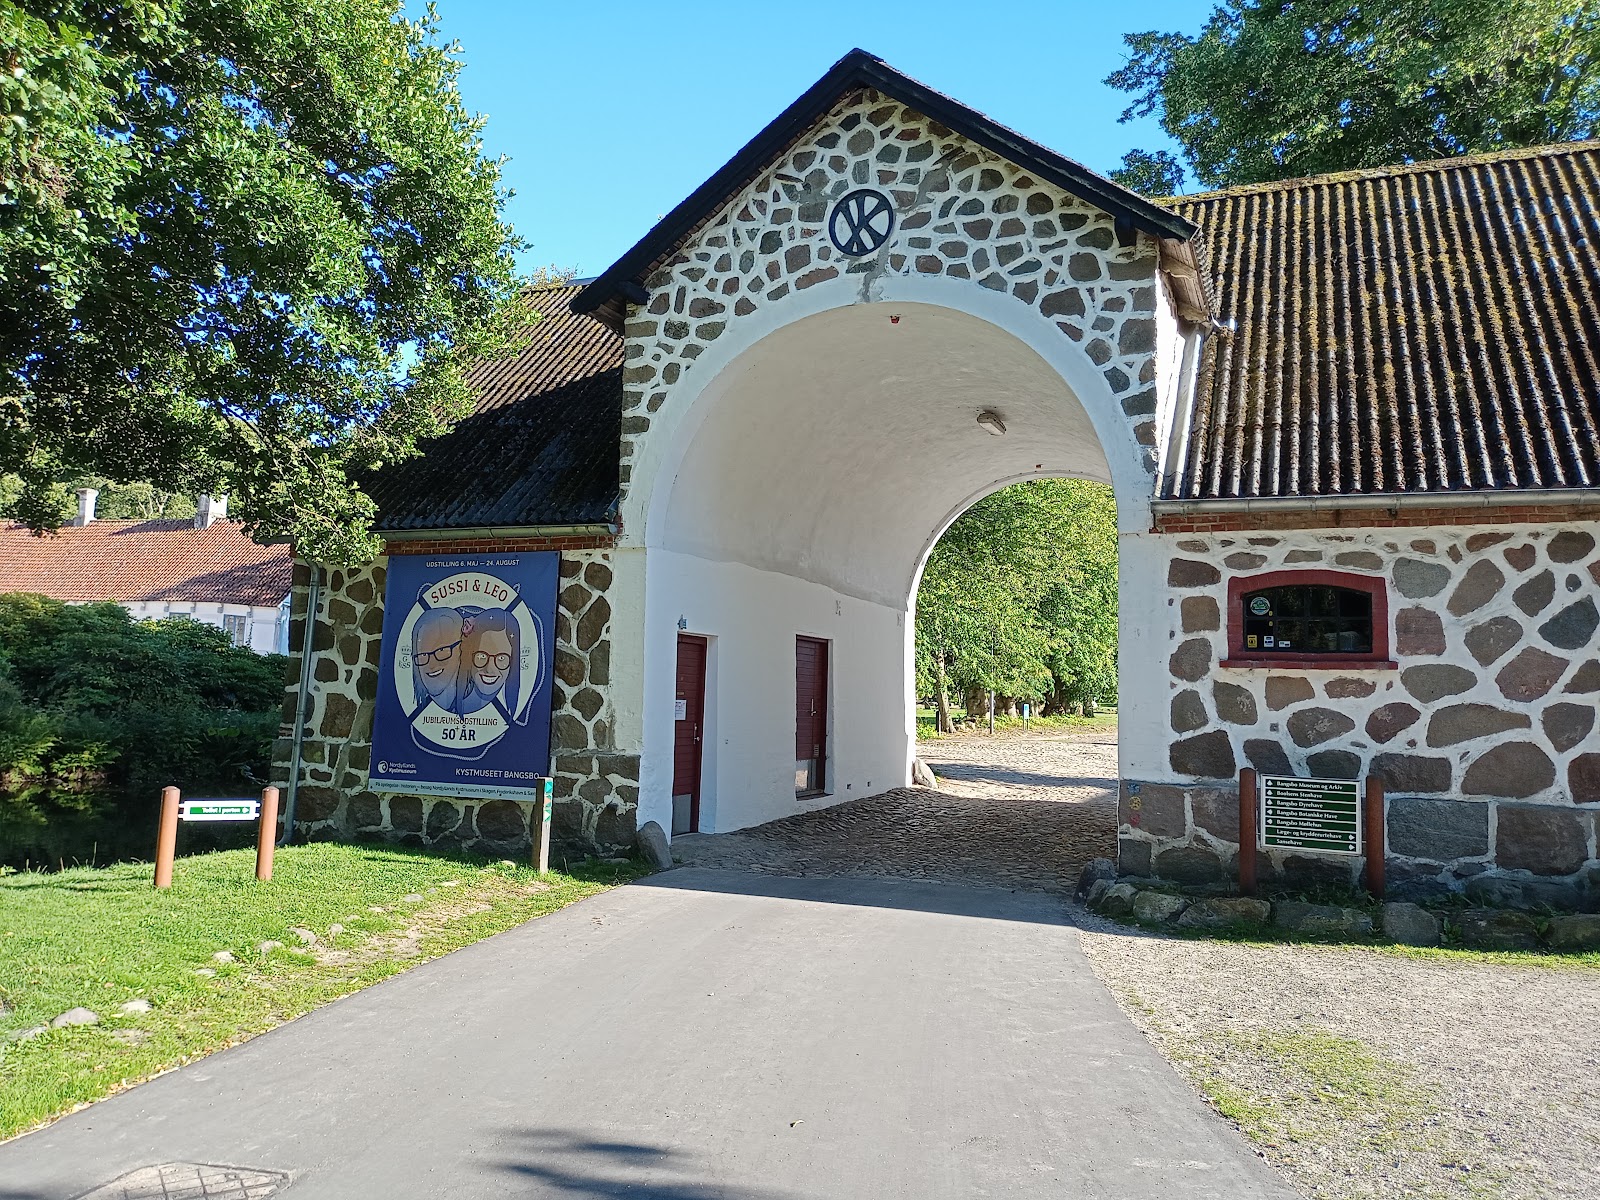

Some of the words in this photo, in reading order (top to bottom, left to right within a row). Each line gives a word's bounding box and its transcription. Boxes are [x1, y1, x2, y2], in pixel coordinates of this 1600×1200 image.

[431, 579, 469, 604] SUSSI
[473, 579, 481, 592] &
[484, 581, 508, 602] LEO
[422, 716, 498, 726] JUBILÆUMSUDSTILLING
[441, 728, 456, 740] 50
[459, 725, 476, 741] ÅR
[455, 768, 502, 777] KYSTMUSEET
[503, 771, 540, 780] BANGSBO
[1300, 830, 1342, 838] krydderurtehave
